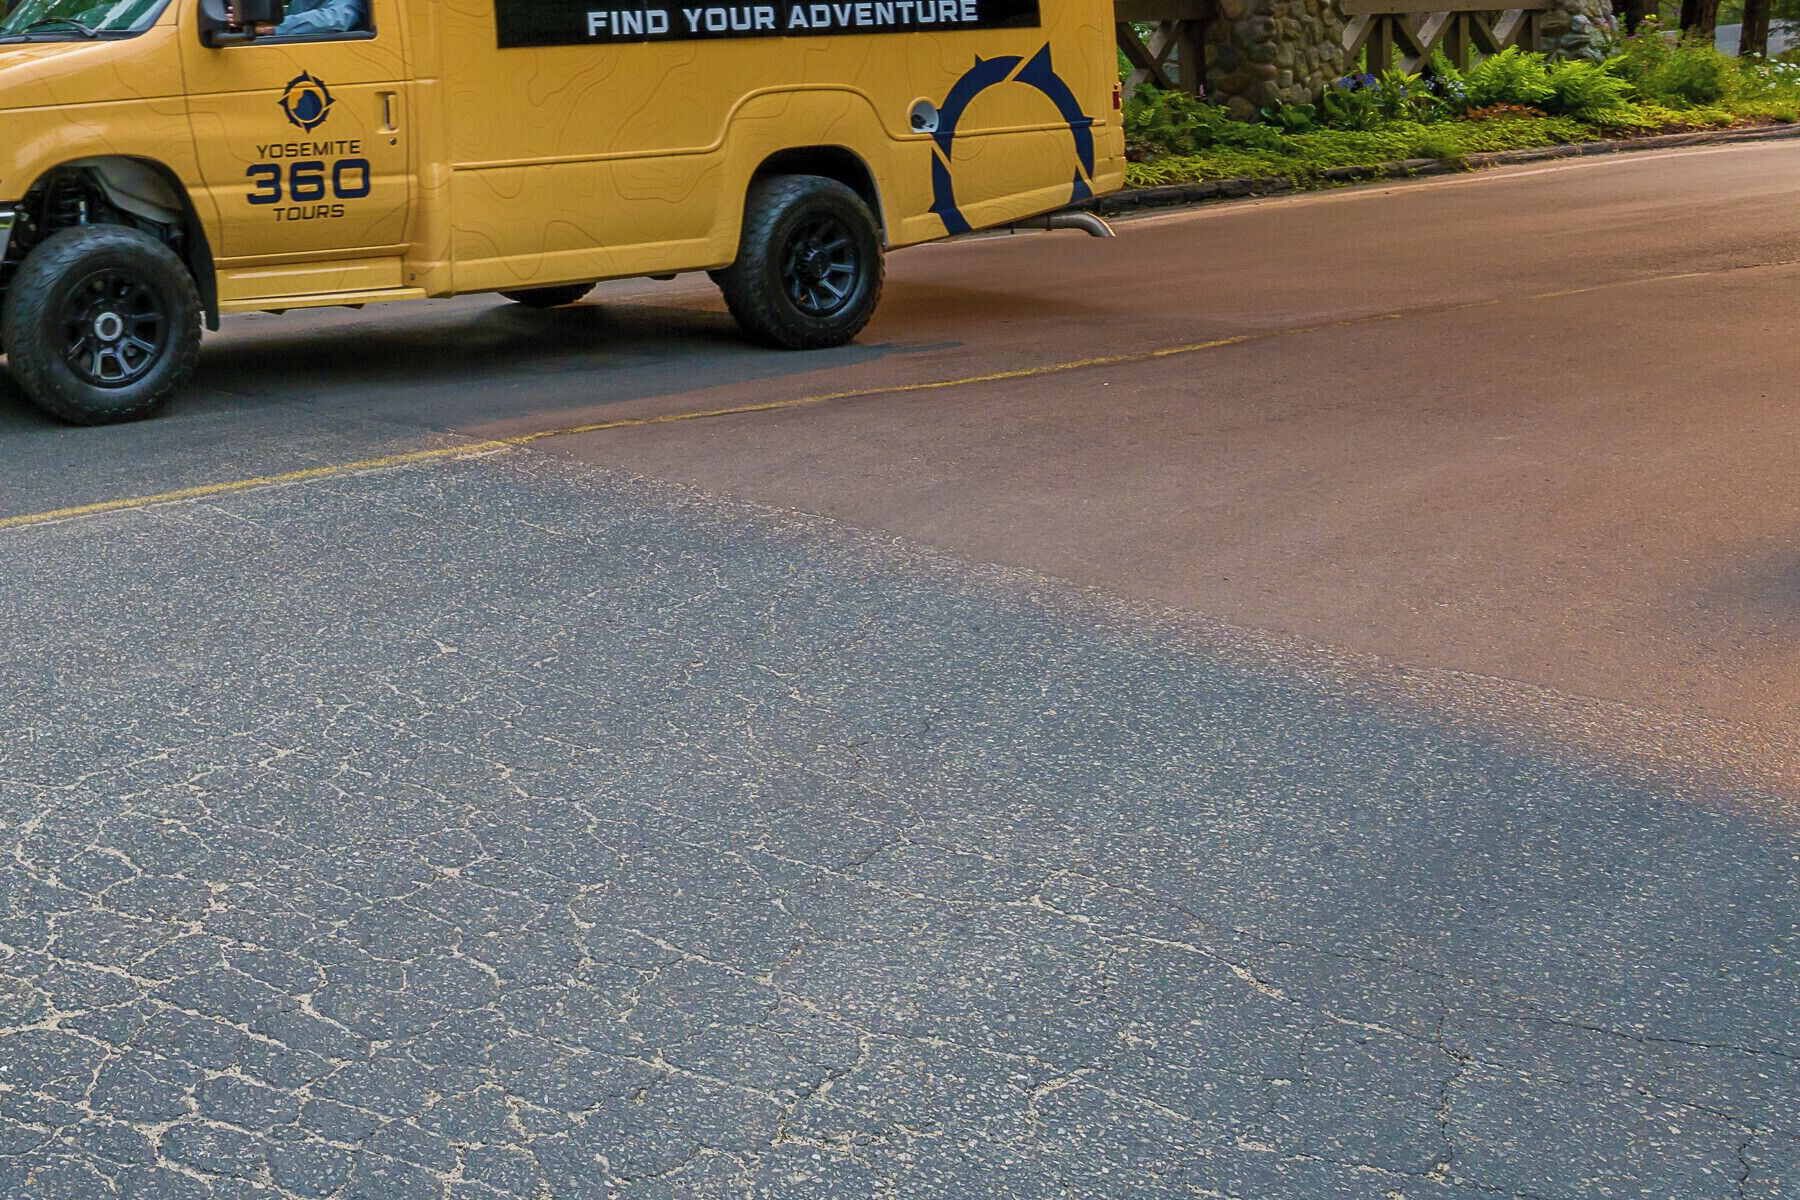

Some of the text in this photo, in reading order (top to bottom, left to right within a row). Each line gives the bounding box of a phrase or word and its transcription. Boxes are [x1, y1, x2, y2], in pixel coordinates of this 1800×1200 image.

[587, 9, 669, 36] FIND
[682, 6, 776, 33] YOUR
[256, 140, 361, 159] YOSEMITE
[246, 158, 370, 205] 360
[273, 204, 345, 221] TOURS
